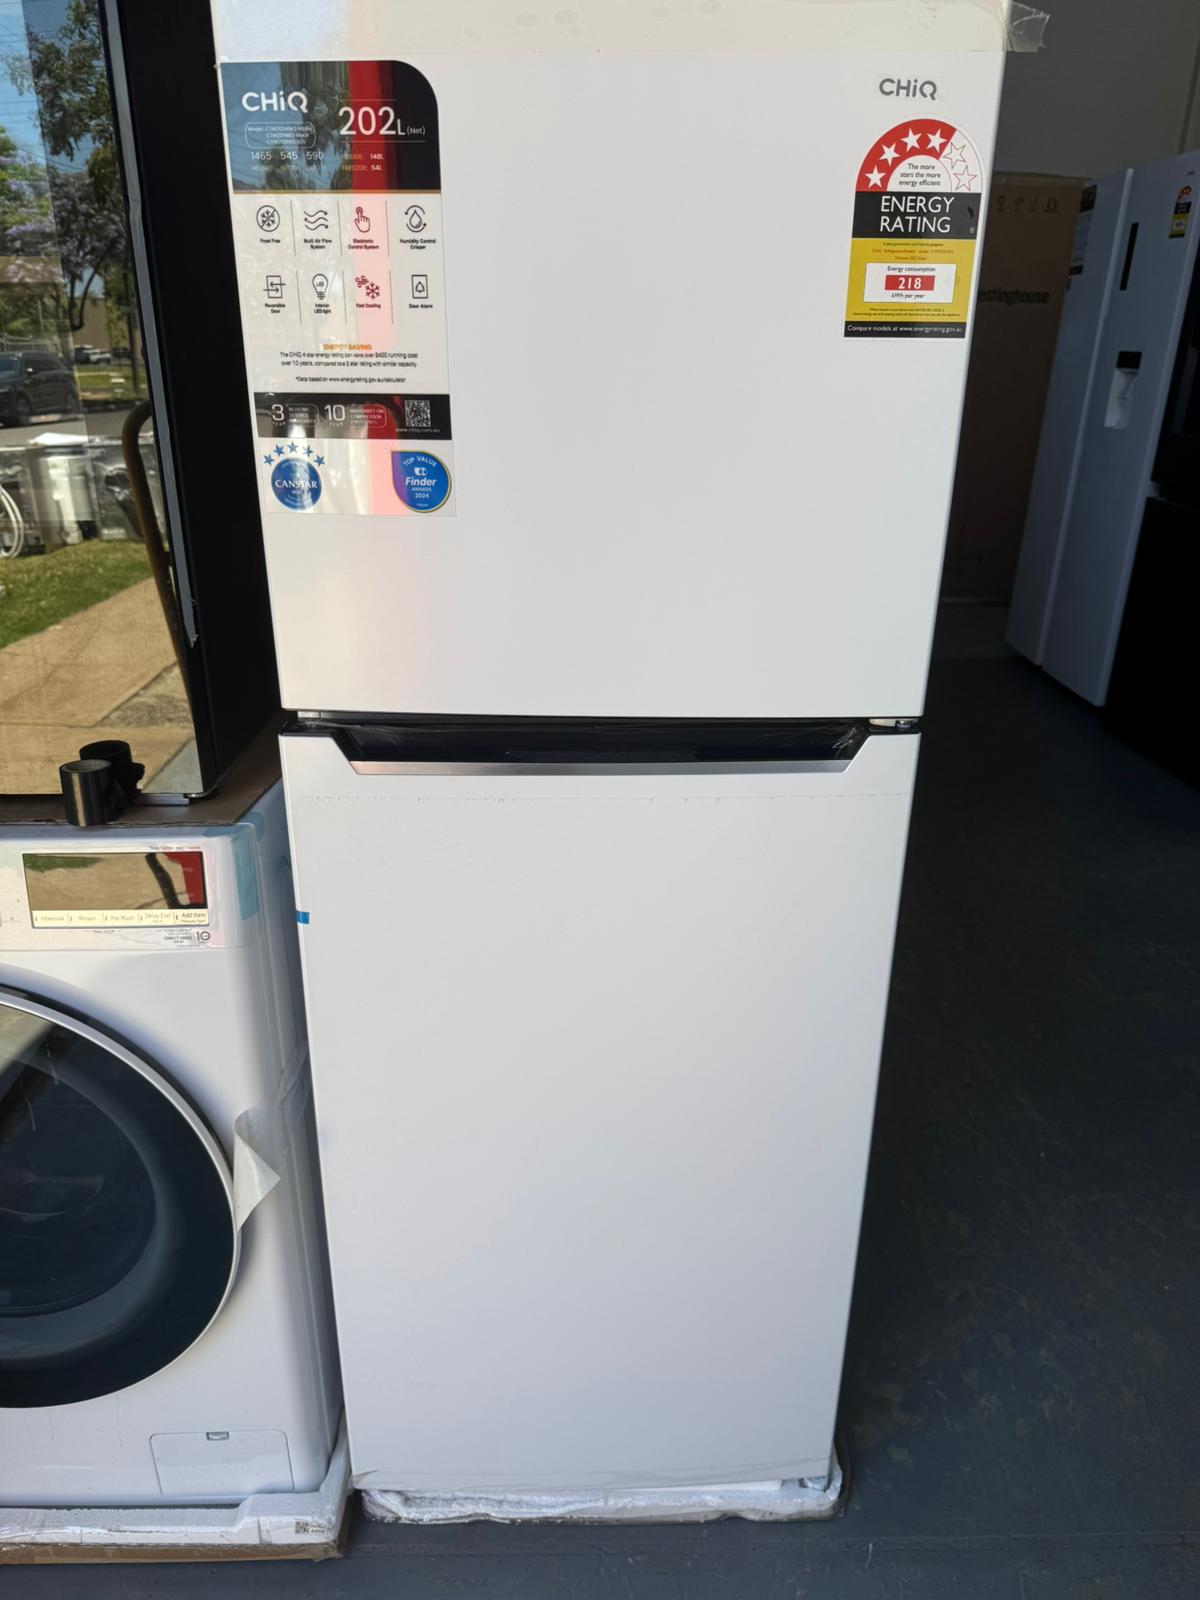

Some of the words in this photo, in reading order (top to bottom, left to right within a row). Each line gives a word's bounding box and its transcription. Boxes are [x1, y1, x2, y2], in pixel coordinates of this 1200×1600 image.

[879, 78, 937, 101] CHiQ
[242, 90, 309, 113] CHiQ
[251, 150, 272, 160] 1465
[280, 150, 298, 160] 545
[306, 150, 324, 160] 590
[881, 195, 955, 213] ENERGY
[880, 216, 951, 233] RATING
[899, 277, 922, 290] 218
[272, 404, 285, 421] 3
[324, 404, 346, 421] 10
[403, 456, 414, 465] TOP
[416, 456, 437, 467] VALUE
[275, 480, 317, 488] CANSTAR
[406, 477, 437, 486] Finder
